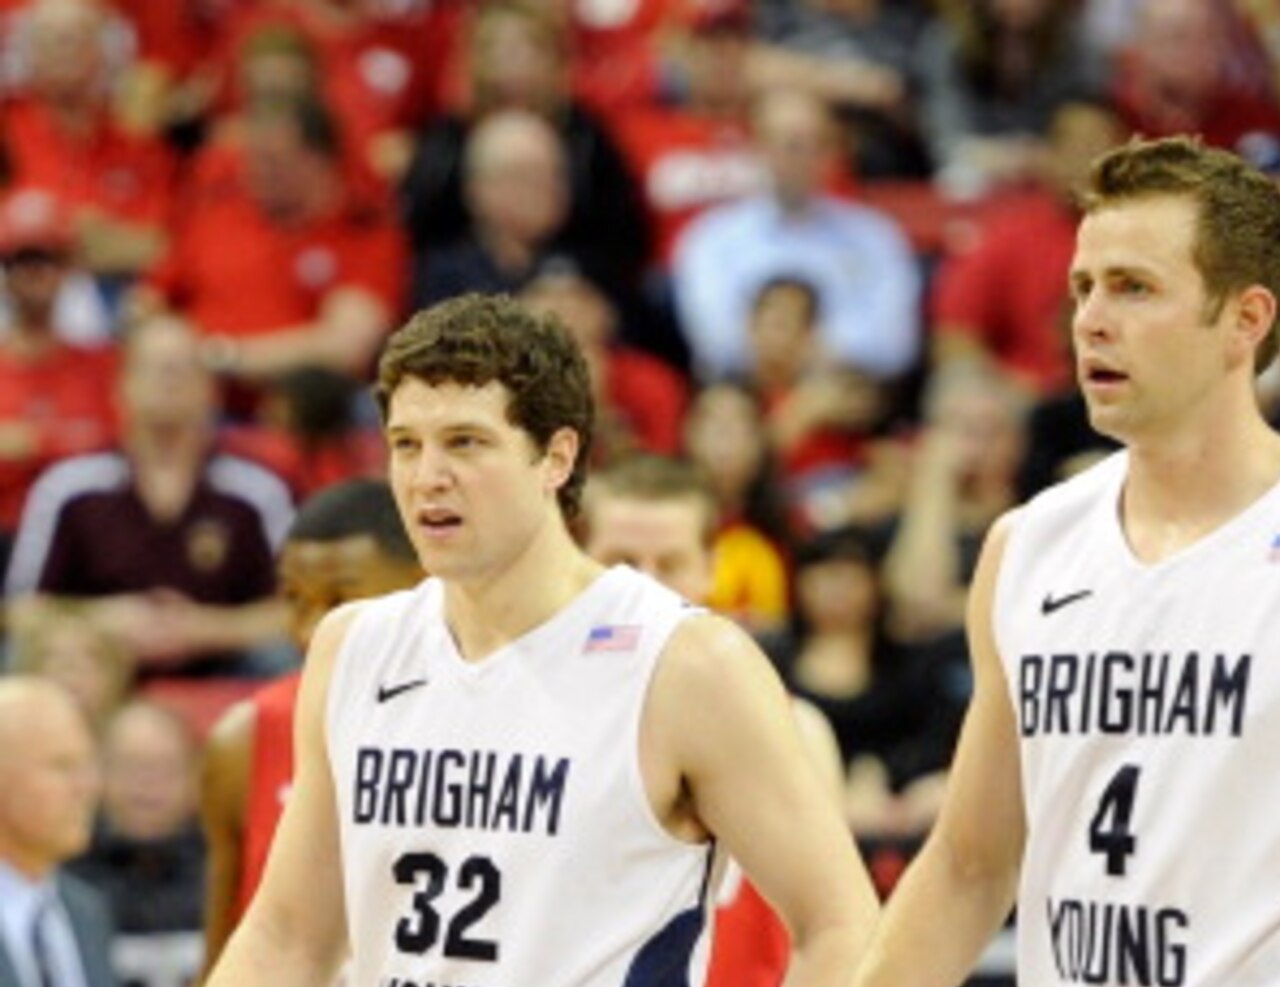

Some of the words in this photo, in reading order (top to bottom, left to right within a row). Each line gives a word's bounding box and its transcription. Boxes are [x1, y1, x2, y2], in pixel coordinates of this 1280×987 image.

[1020, 651, 1251, 737] BRIGHAM
[354, 747, 570, 836] BRIGHAM
[1088, 764, 1140, 876] 4
[391, 851, 501, 962] 32
